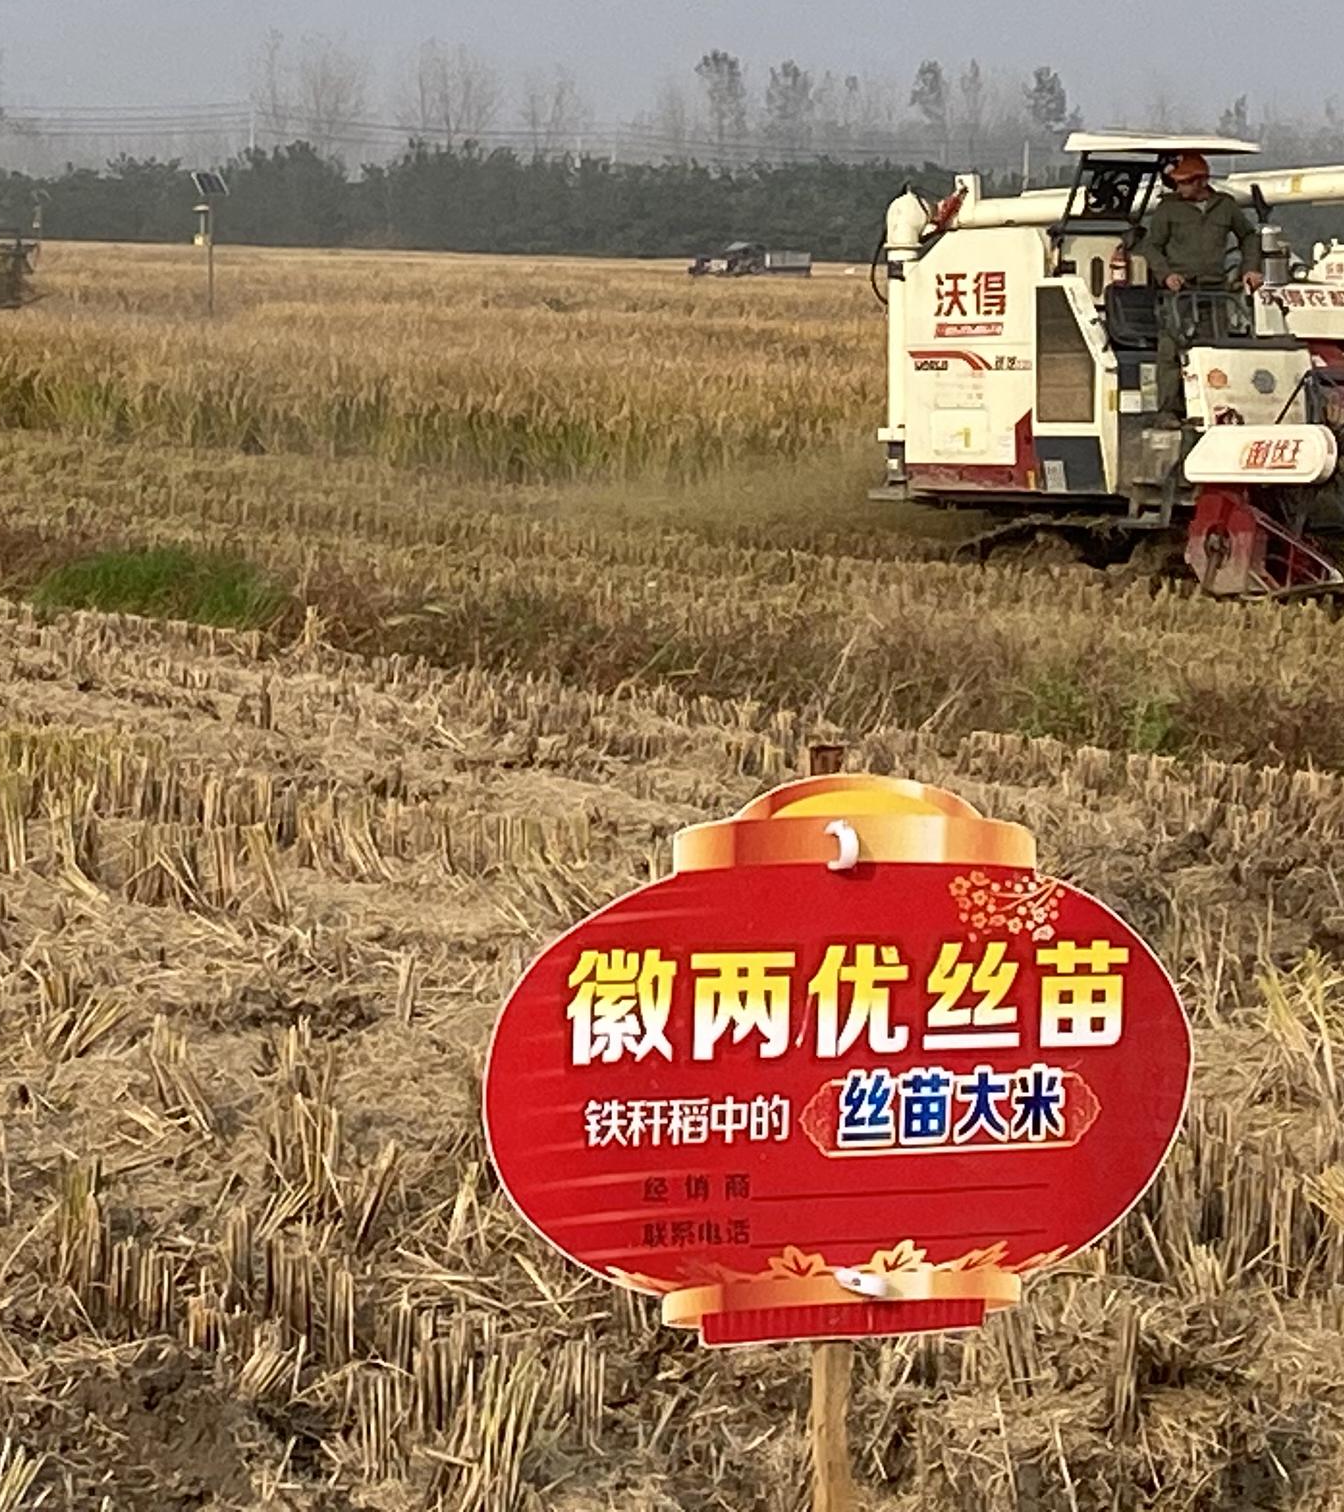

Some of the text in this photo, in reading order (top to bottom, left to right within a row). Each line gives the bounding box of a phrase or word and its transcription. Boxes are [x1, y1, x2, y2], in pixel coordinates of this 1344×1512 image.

[934, 271, 1006, 317] 沃得
[567, 939, 1130, 1066] 徽两优丝苗
[584, 1064, 1064, 1147] 铁秆稻中的 丝苗大米
[643, 1173, 751, 1202] 经销商
[643, 1218, 751, 1247] 联系电话
